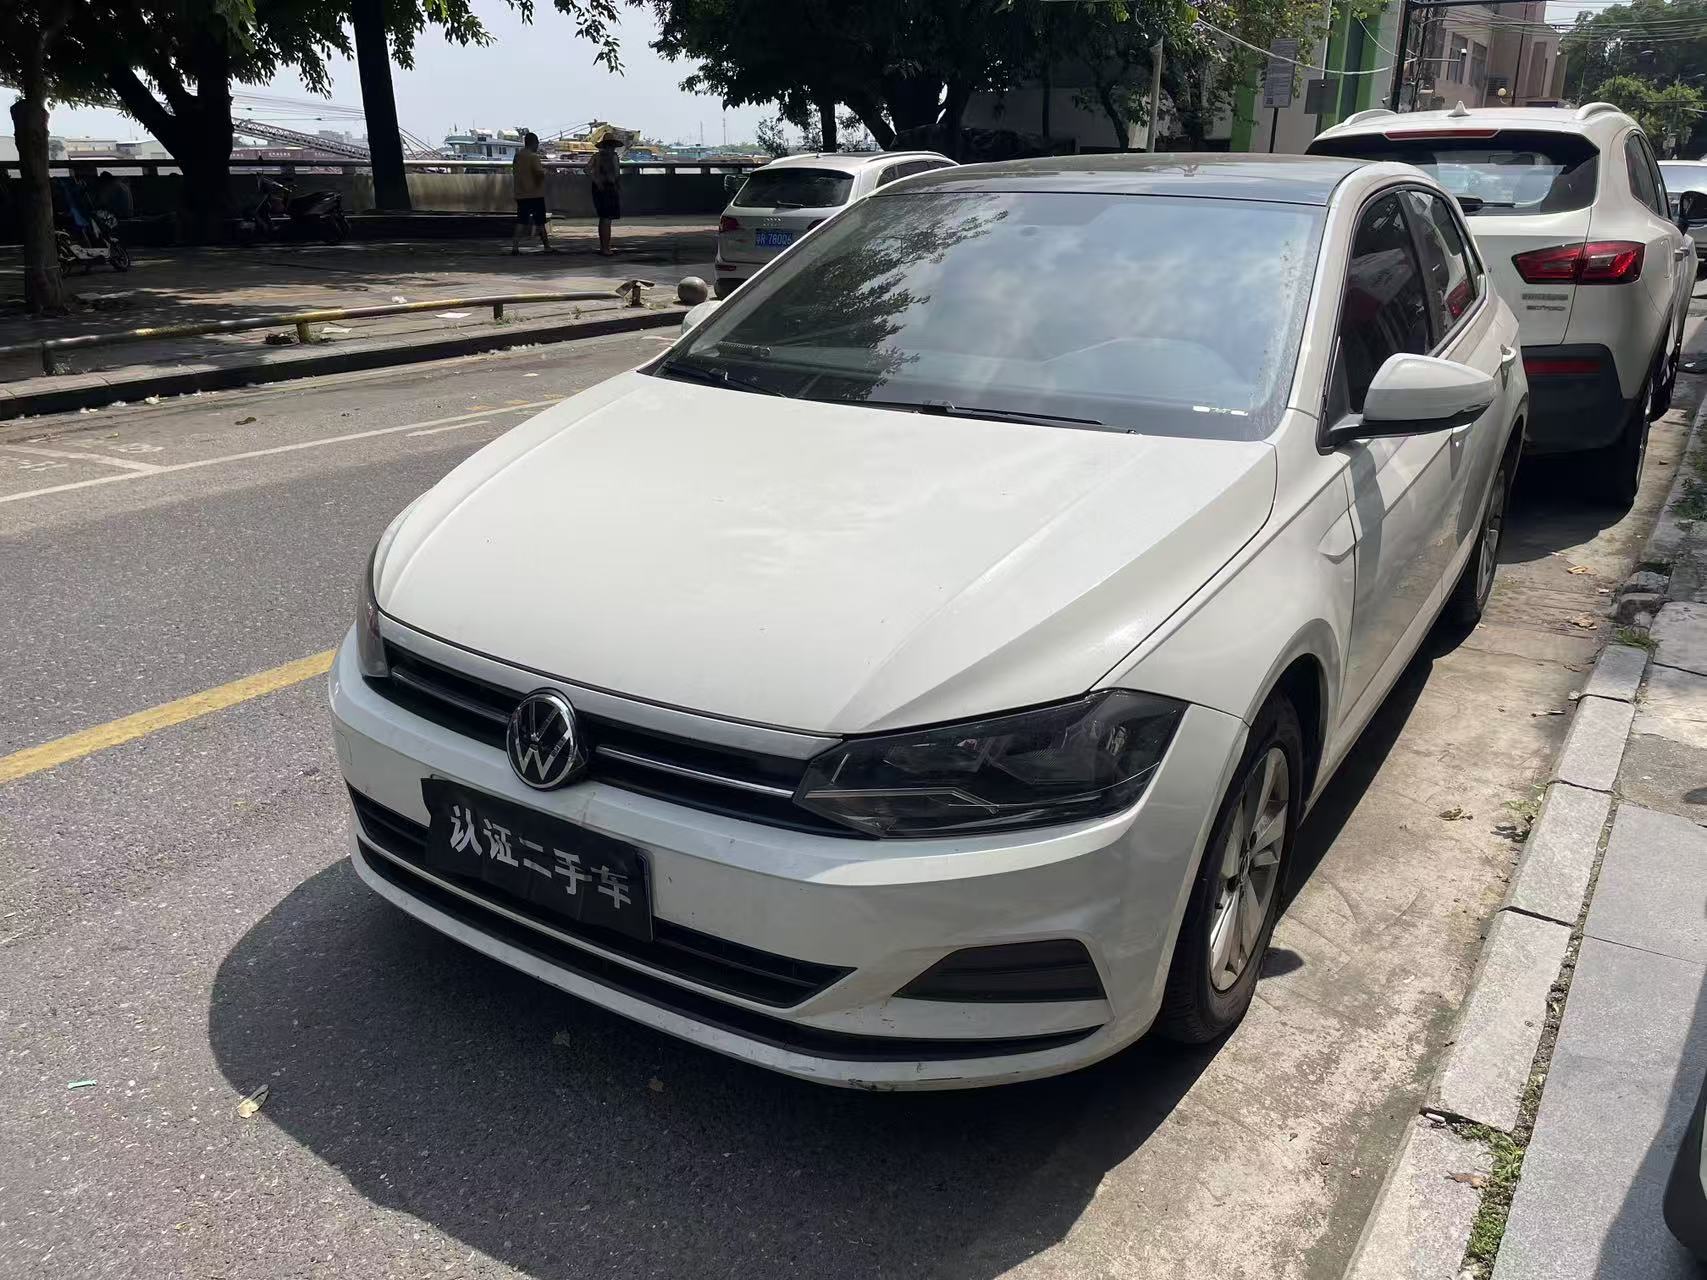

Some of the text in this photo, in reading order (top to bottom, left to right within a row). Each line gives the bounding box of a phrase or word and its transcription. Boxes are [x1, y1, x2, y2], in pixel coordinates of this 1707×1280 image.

[512, 700, 572, 781] VW
[450, 804, 632, 909] 认证二手车
